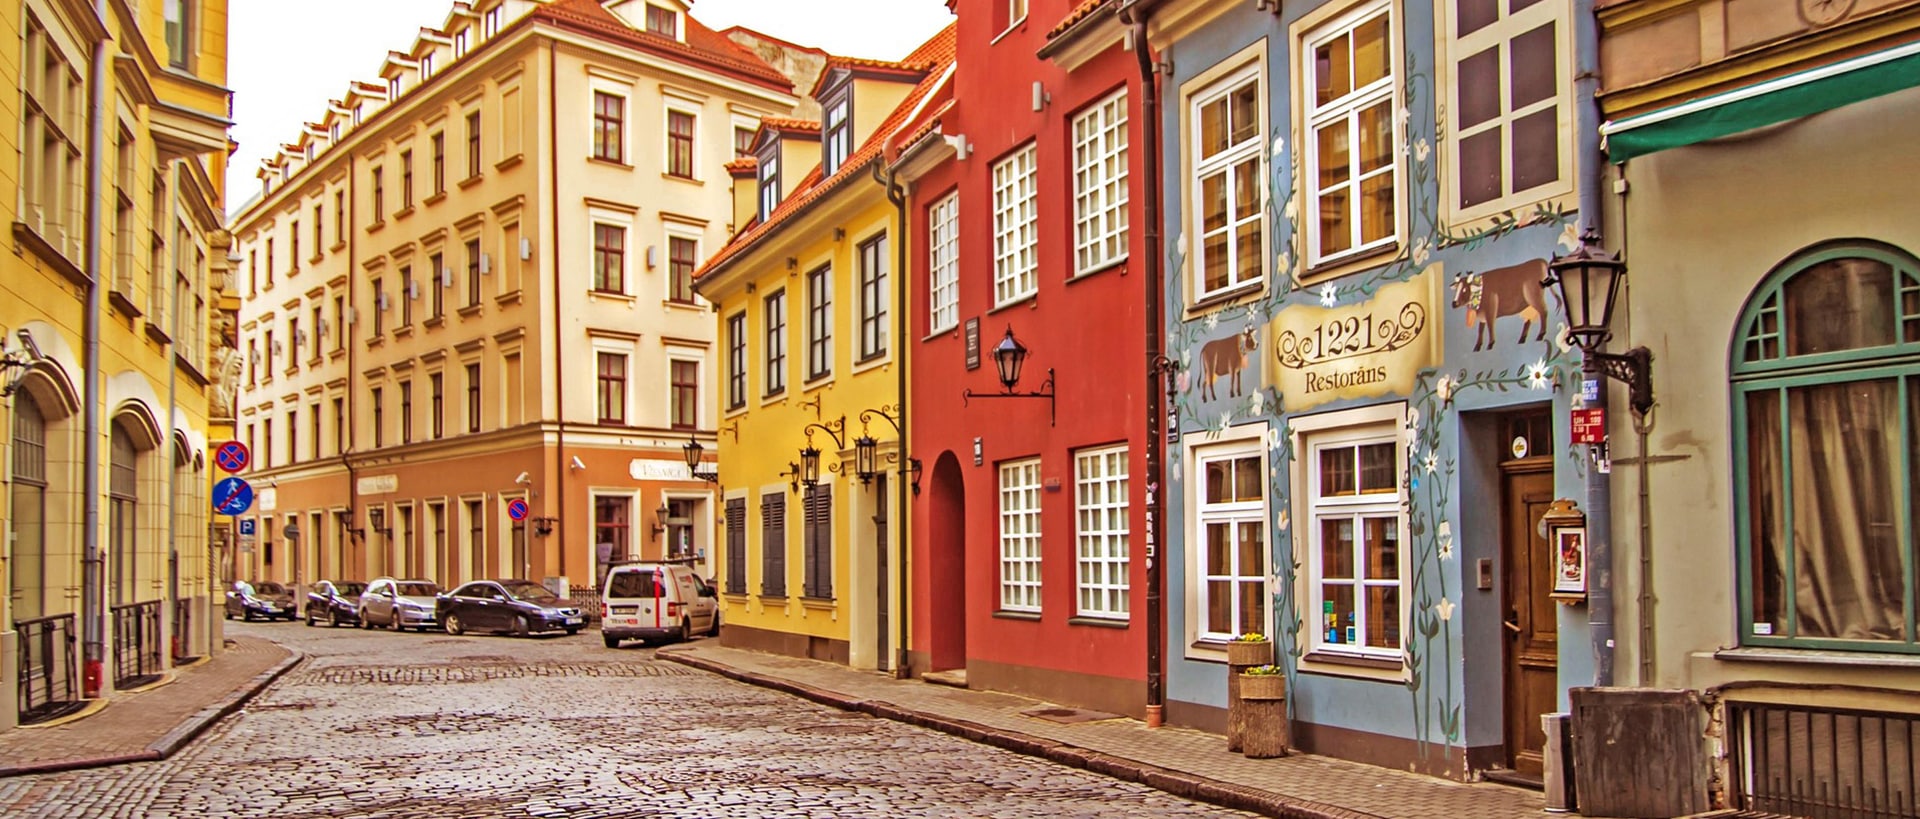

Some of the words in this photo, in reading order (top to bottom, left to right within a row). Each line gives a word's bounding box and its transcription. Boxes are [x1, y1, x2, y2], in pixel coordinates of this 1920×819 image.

[1313, 313, 1376, 359] 1221
[1305, 366, 1387, 394] Restorāns
[242, 521, 253, 533] P
